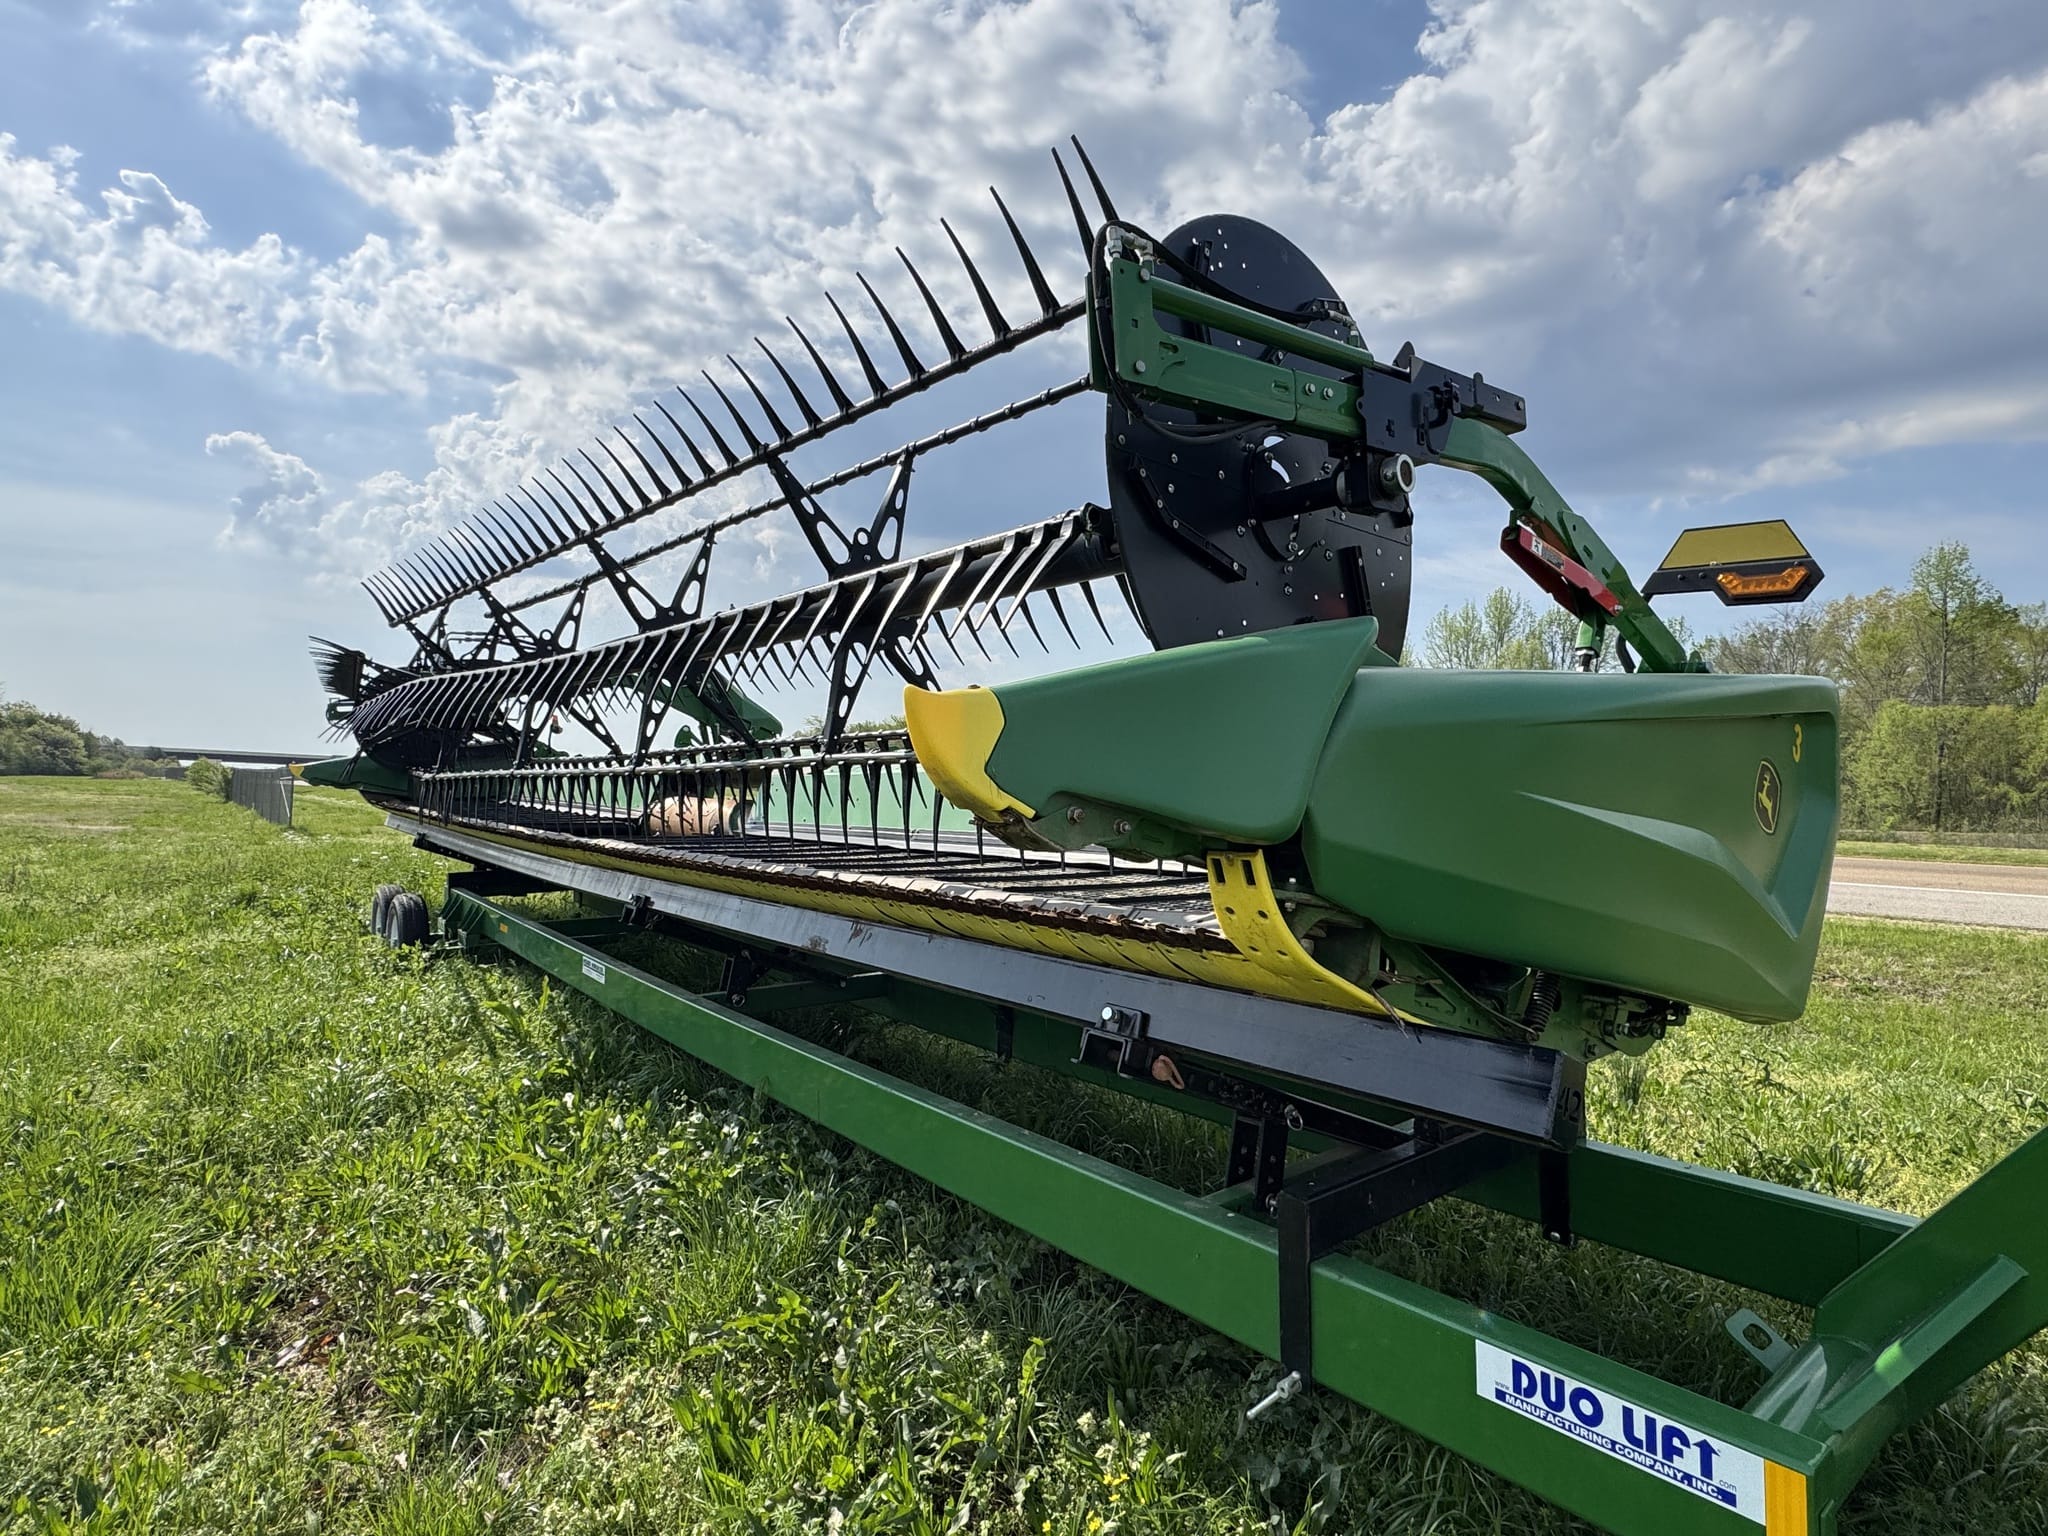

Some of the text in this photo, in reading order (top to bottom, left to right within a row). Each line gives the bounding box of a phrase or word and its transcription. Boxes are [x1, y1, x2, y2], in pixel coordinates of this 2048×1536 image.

[1792, 723, 1803, 763] 3
[1557, 1088, 1581, 1122] 42
[1512, 1358, 1604, 1428] DUO
[1505, 1394, 1723, 1500] MANUFACTURING COMPANY, INC.
